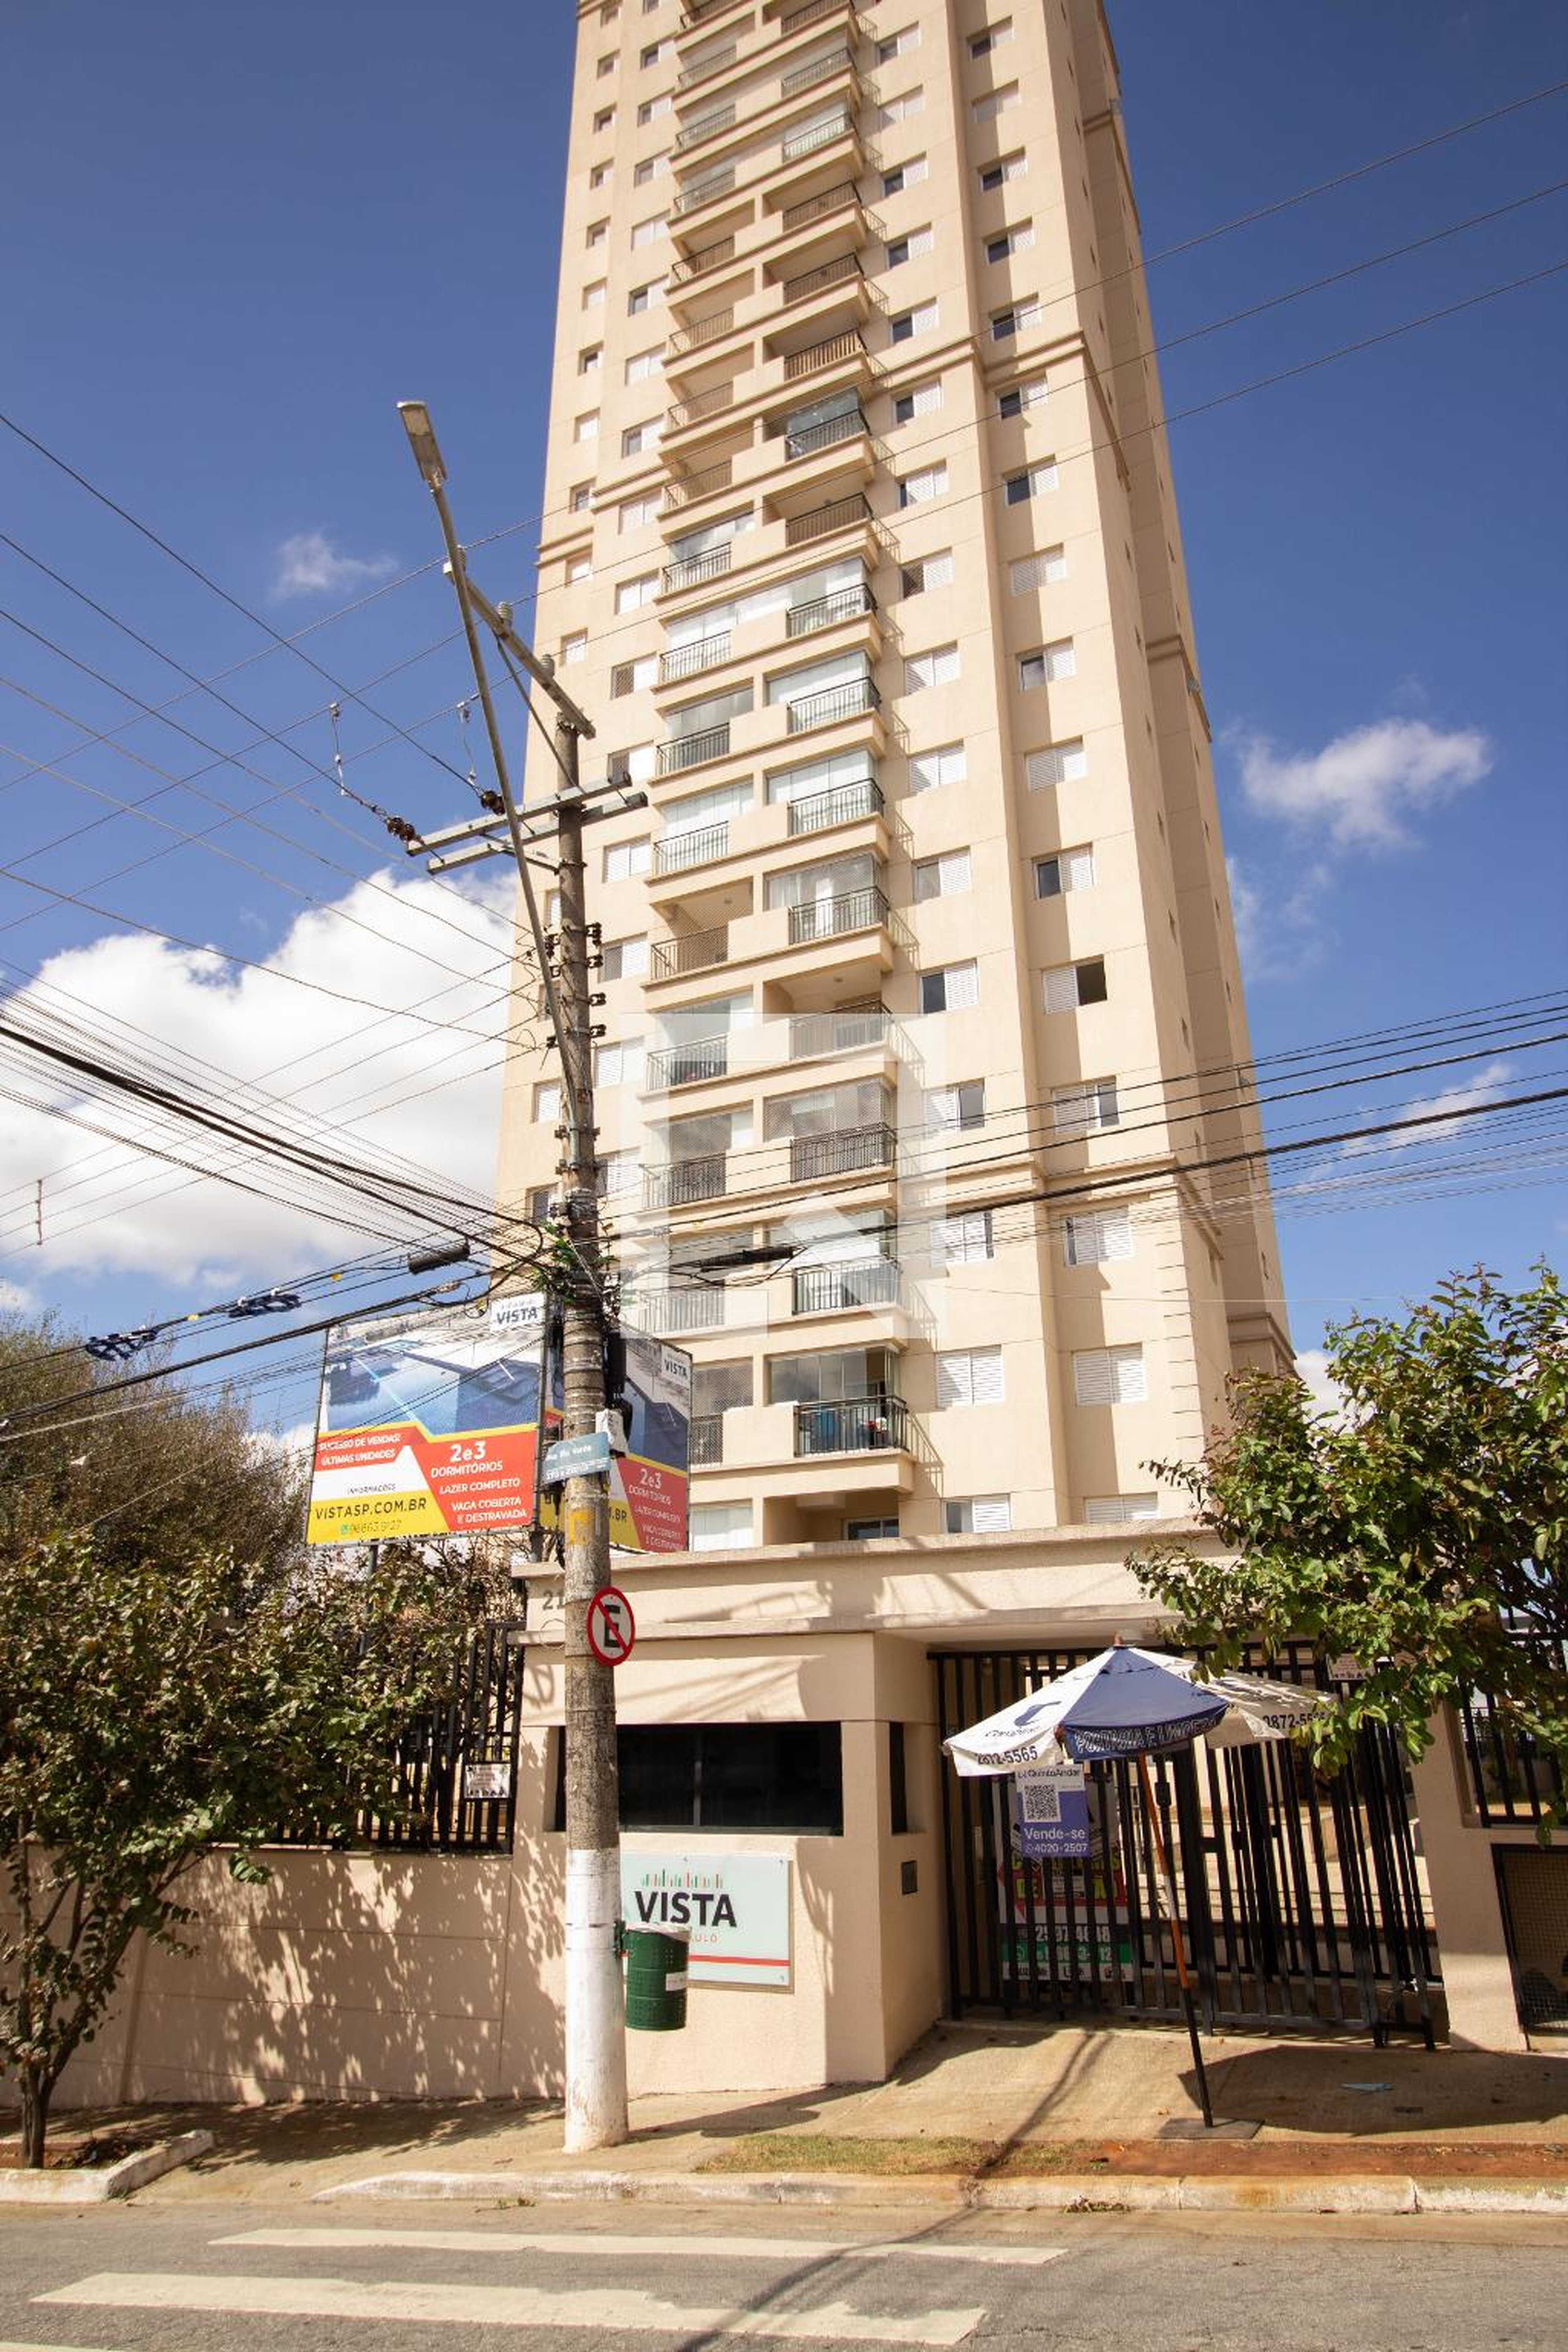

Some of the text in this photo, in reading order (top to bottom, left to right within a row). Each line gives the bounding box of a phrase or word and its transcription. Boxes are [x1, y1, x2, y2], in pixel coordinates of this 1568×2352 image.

[497, 1307, 538, 1324] VISTA
[664, 1359, 688, 1379] VISTA
[355, 1438, 366, 1446] DE
[431, 1460, 503, 1478] DORMITÓRIOS
[439, 1478, 521, 1494] LAZER COMPLETO
[315, 1498, 426, 1519] VISTASP.COM.BR
[452, 1496, 521, 1511] VAGA COBERTA
[1024, 1828, 1086, 1840] Vende-se
[634, 1891, 737, 1928] VISTA
